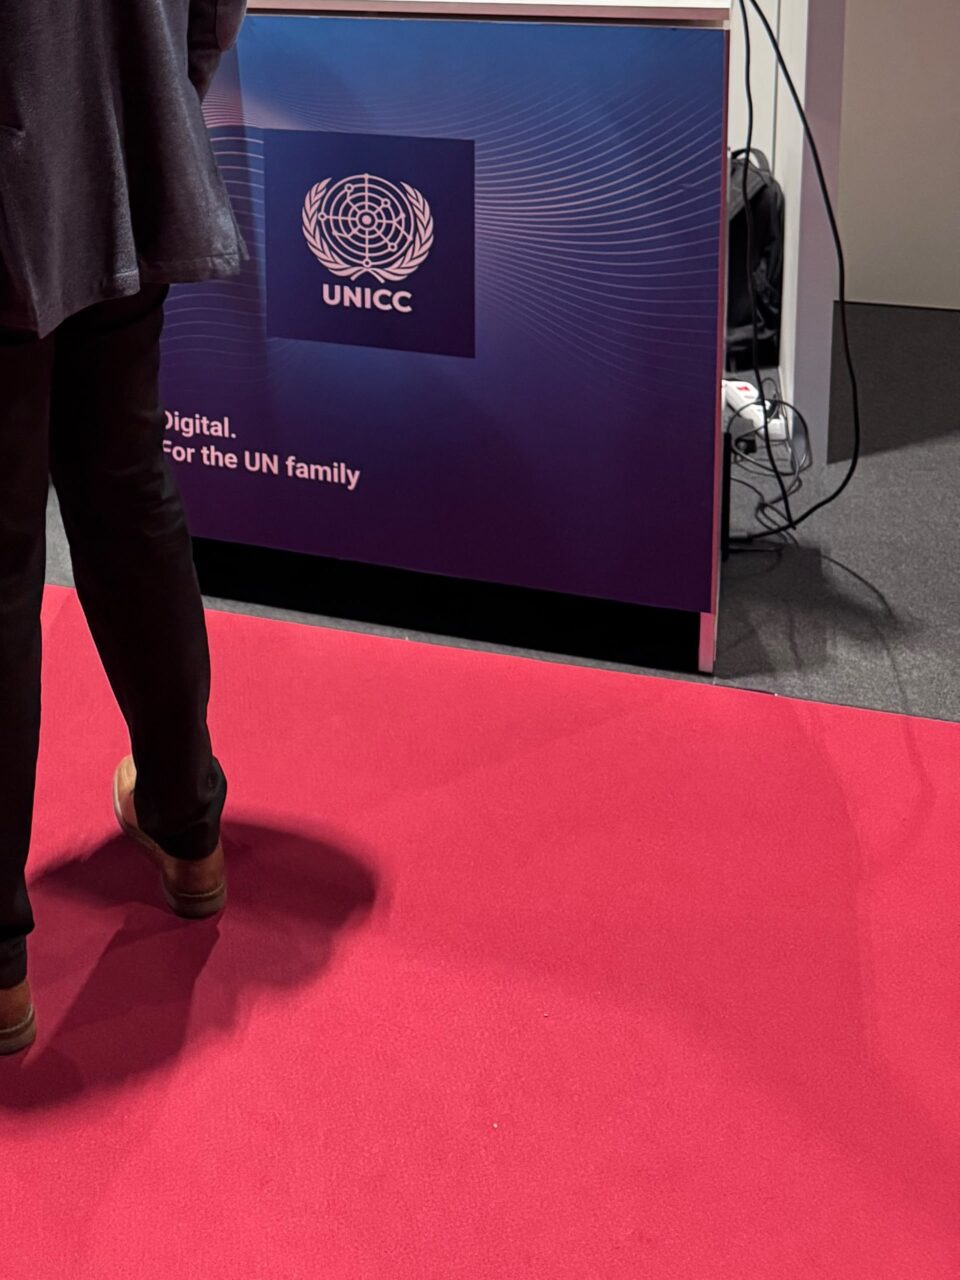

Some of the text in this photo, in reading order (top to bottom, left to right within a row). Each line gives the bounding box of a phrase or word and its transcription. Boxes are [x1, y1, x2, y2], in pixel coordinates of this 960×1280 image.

[322, 283, 413, 313] UNICC
[200, 445, 238, 469] the
[244, 450, 279, 476] UN
[285, 456, 360, 490] family
